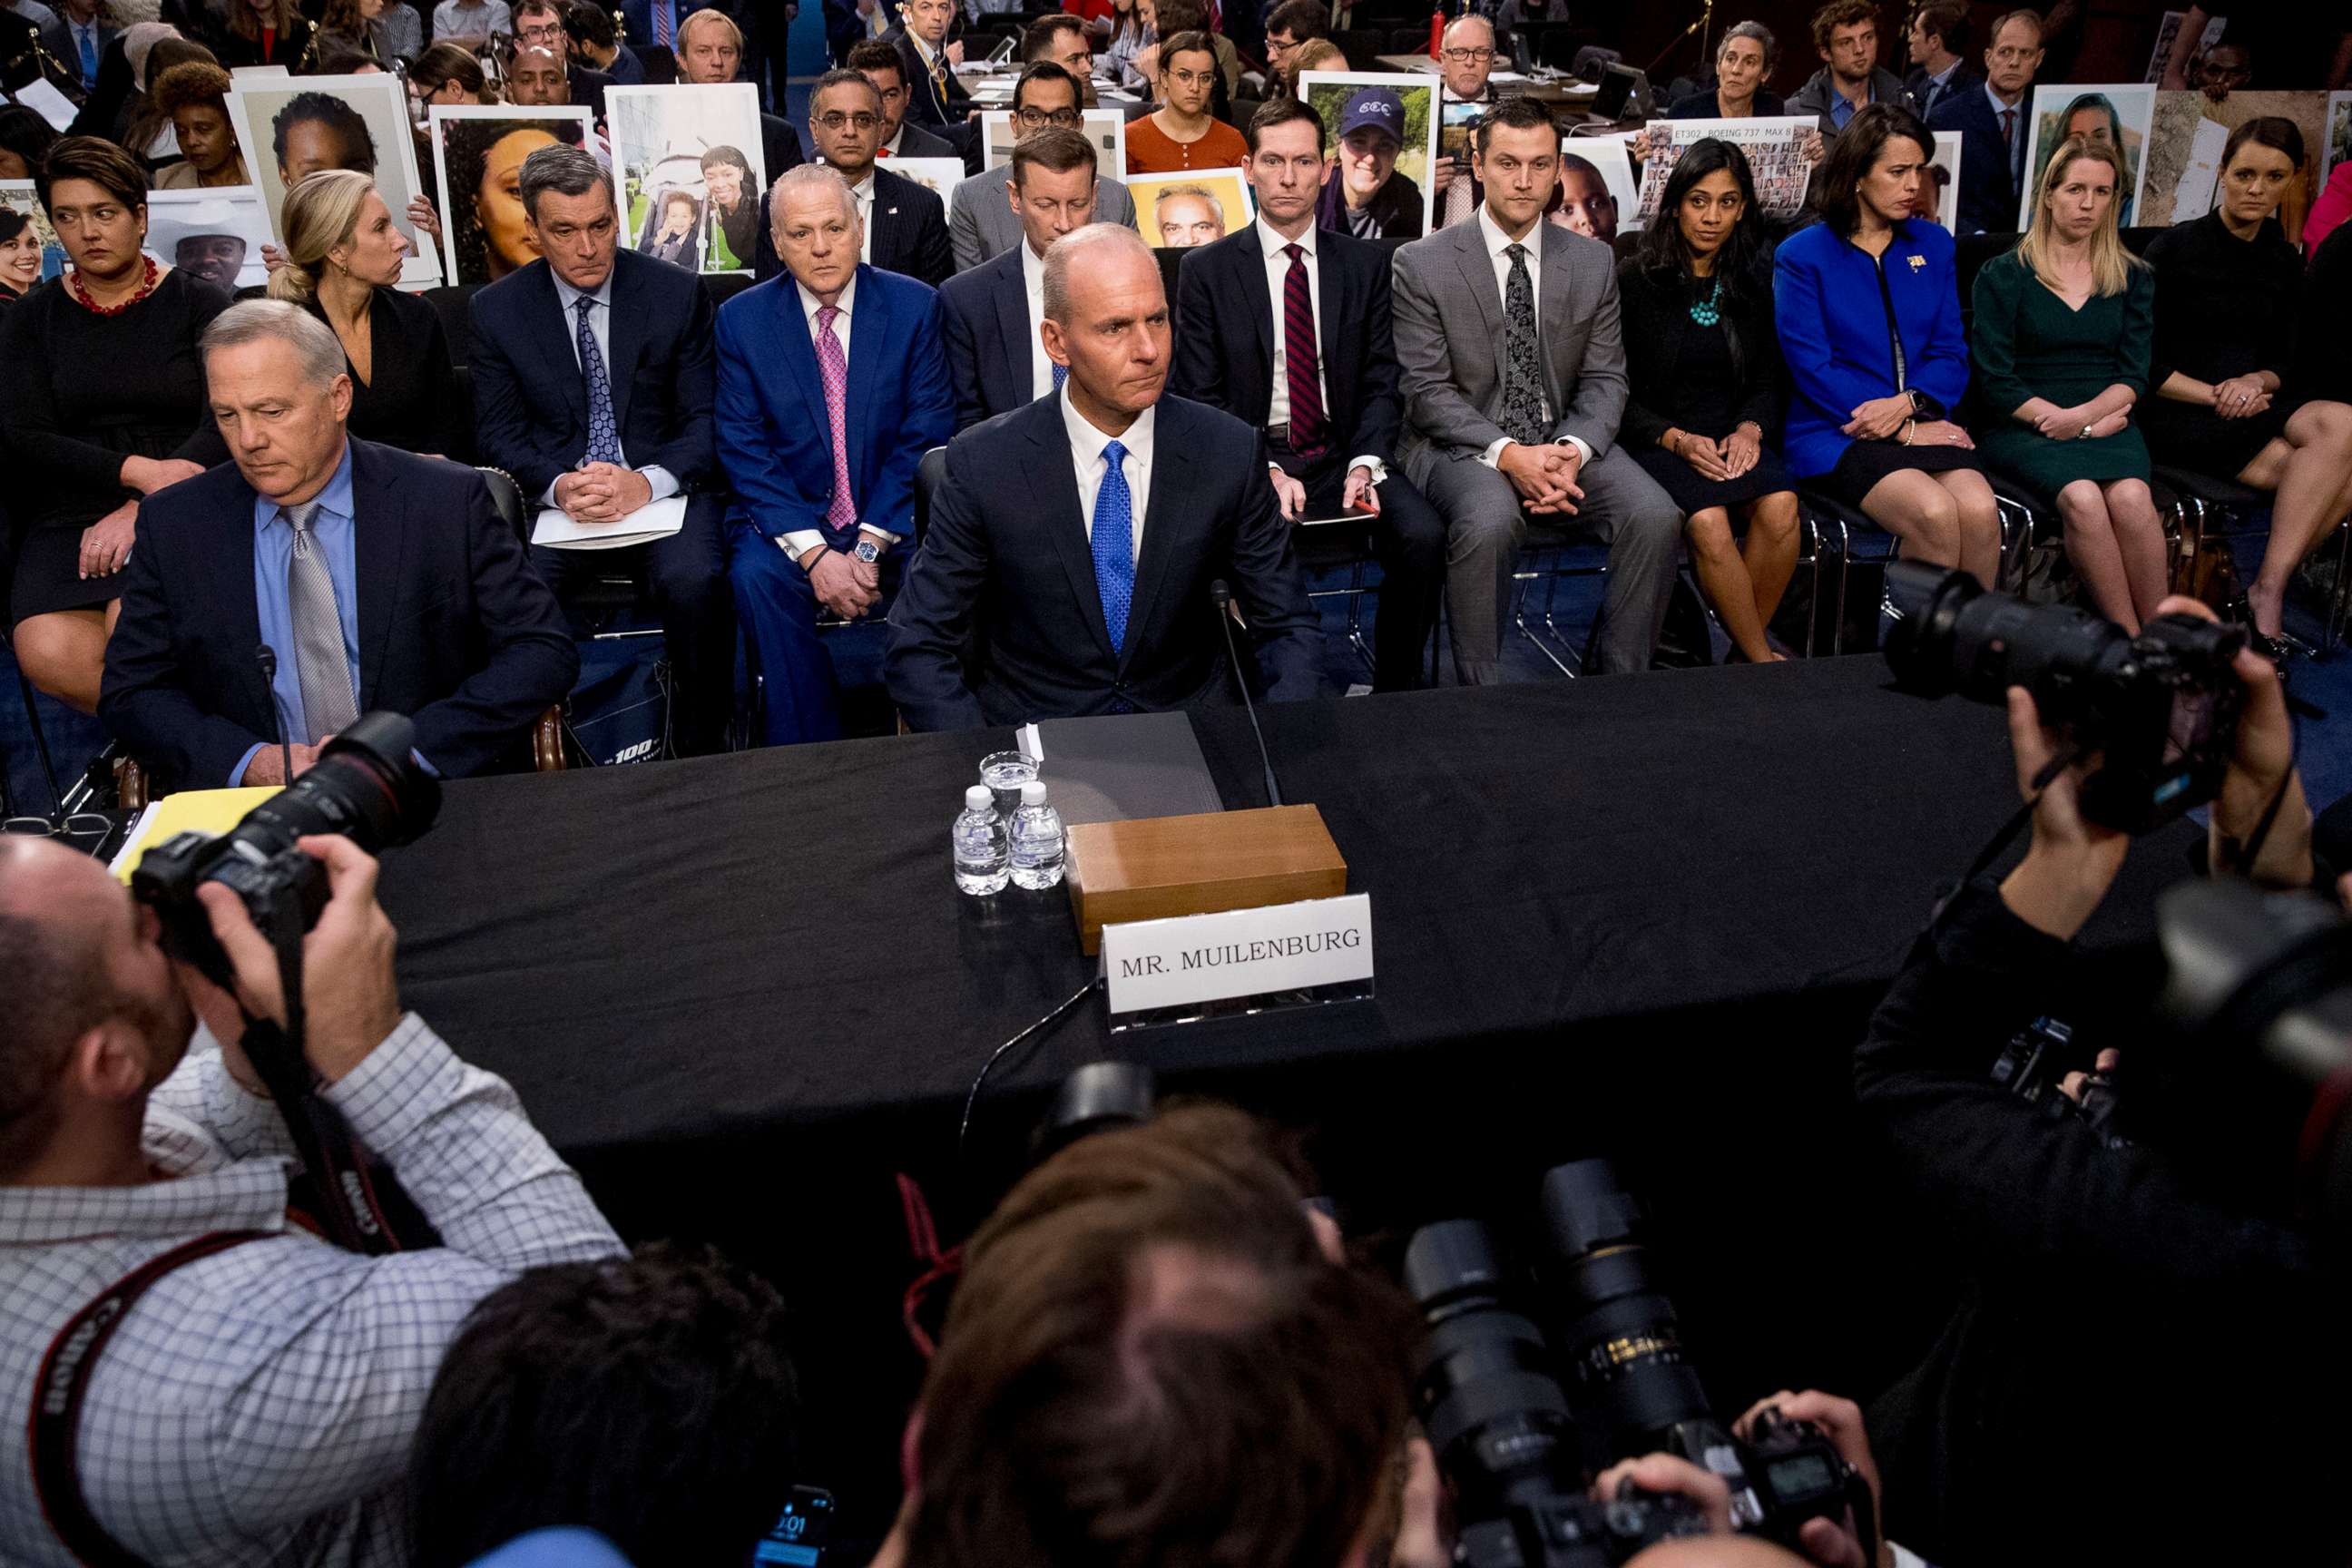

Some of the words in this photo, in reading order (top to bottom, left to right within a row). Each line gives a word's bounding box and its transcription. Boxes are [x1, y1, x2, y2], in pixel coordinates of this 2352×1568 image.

[1674, 130, 1701, 139] ET302
[1708, 129, 1742, 138] BOEING
[1744, 128, 1760, 137] 737
[1764, 127, 1783, 137] MAX
[1785, 127, 1792, 136] 8
[616, 739, 652, 764] 100
[1122, 956, 1170, 977] MR.
[1181, 929, 1360, 970] MUILENBURG
